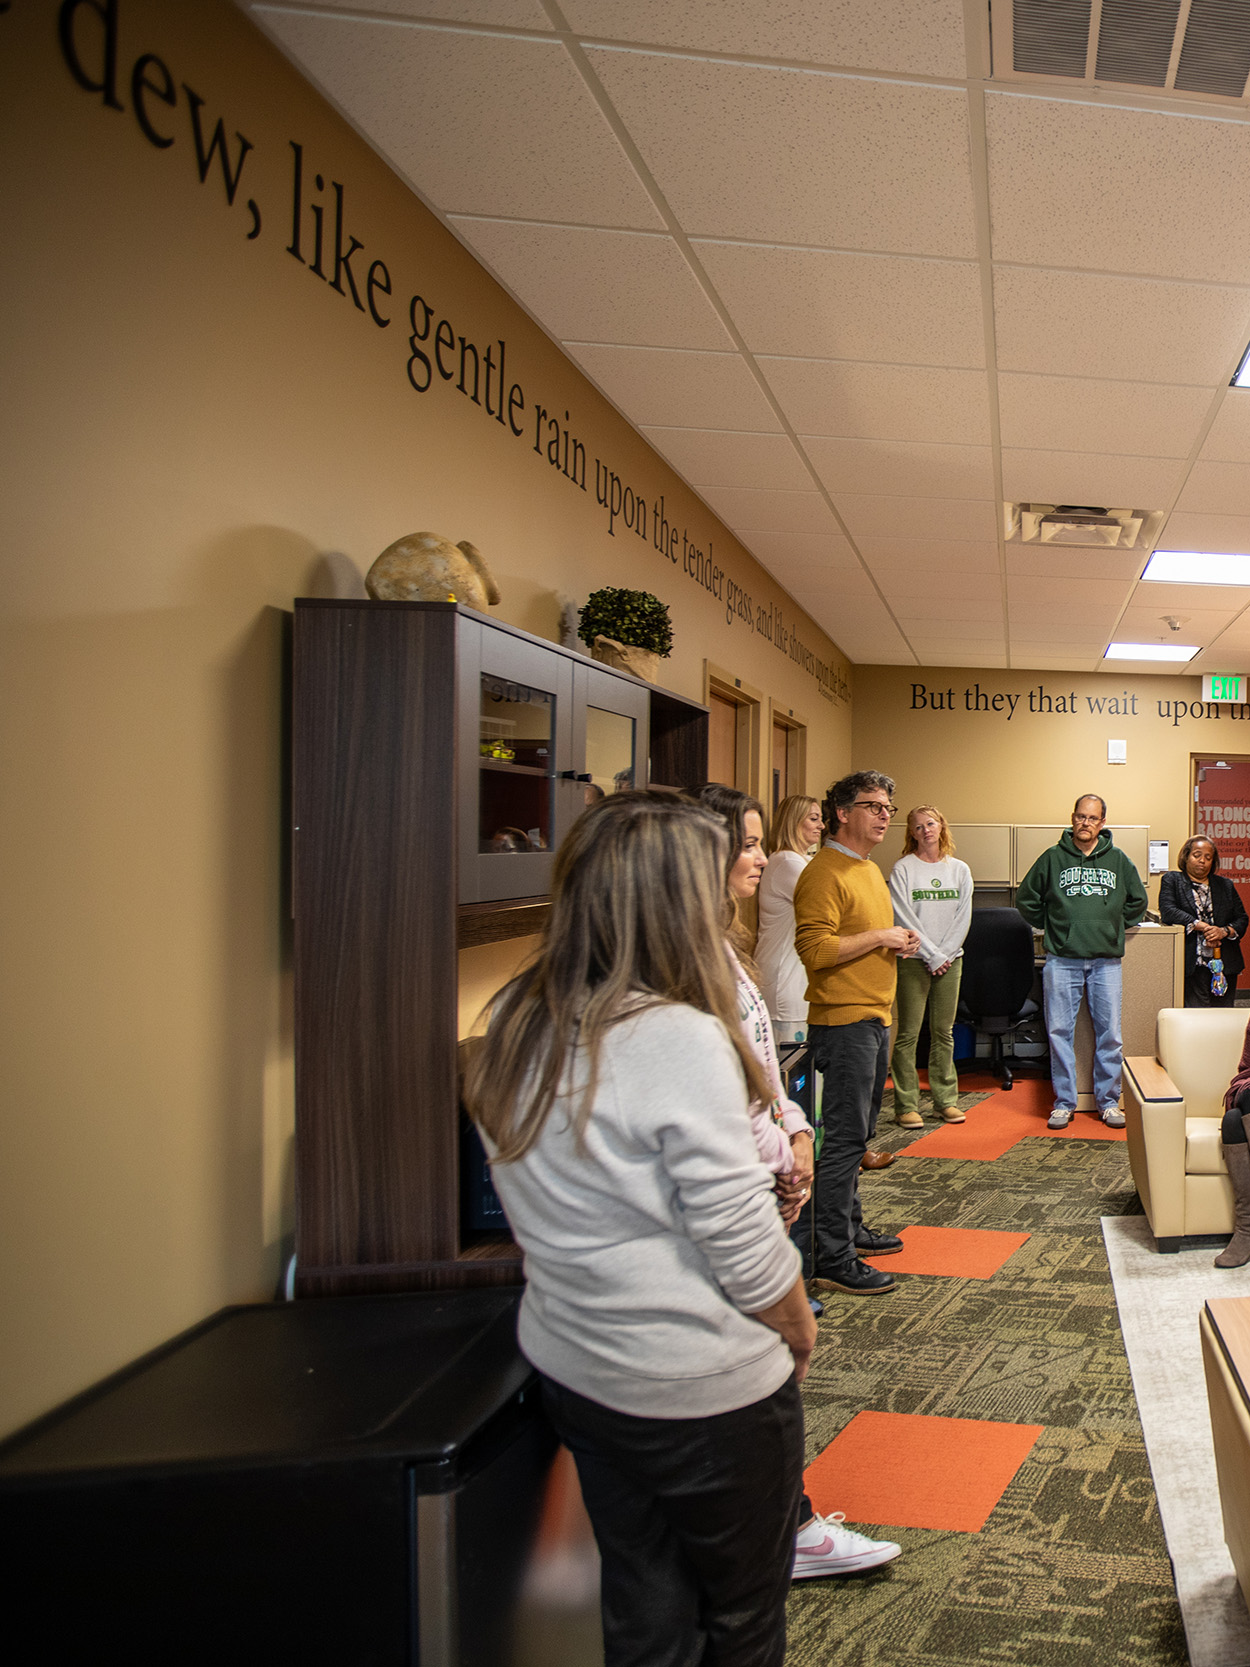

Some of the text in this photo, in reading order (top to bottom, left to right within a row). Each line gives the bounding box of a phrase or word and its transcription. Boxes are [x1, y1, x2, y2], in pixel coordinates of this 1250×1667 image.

[57, 0, 262, 239] dew,
[286, 140, 393, 328] like
[406, 295, 525, 437] gentle
[533, 402, 588, 491] rain
[595, 458, 648, 541] upon
[653, 496, 679, 565] the
[683, 528, 725, 602] tender
[726, 578, 755, 634] grass,
[756, 601, 773, 642] and
[774, 606, 789, 655] like
[909, 683, 956, 711] But
[964, 683, 1021, 721] they
[1028, 685, 1078, 714] that
[1085, 690, 1139, 716] wait
[1157, 699, 1221, 727] upon
[1211, 676, 1241, 700] EXIT
[1059, 866, 1117, 889] SOUTHERN
